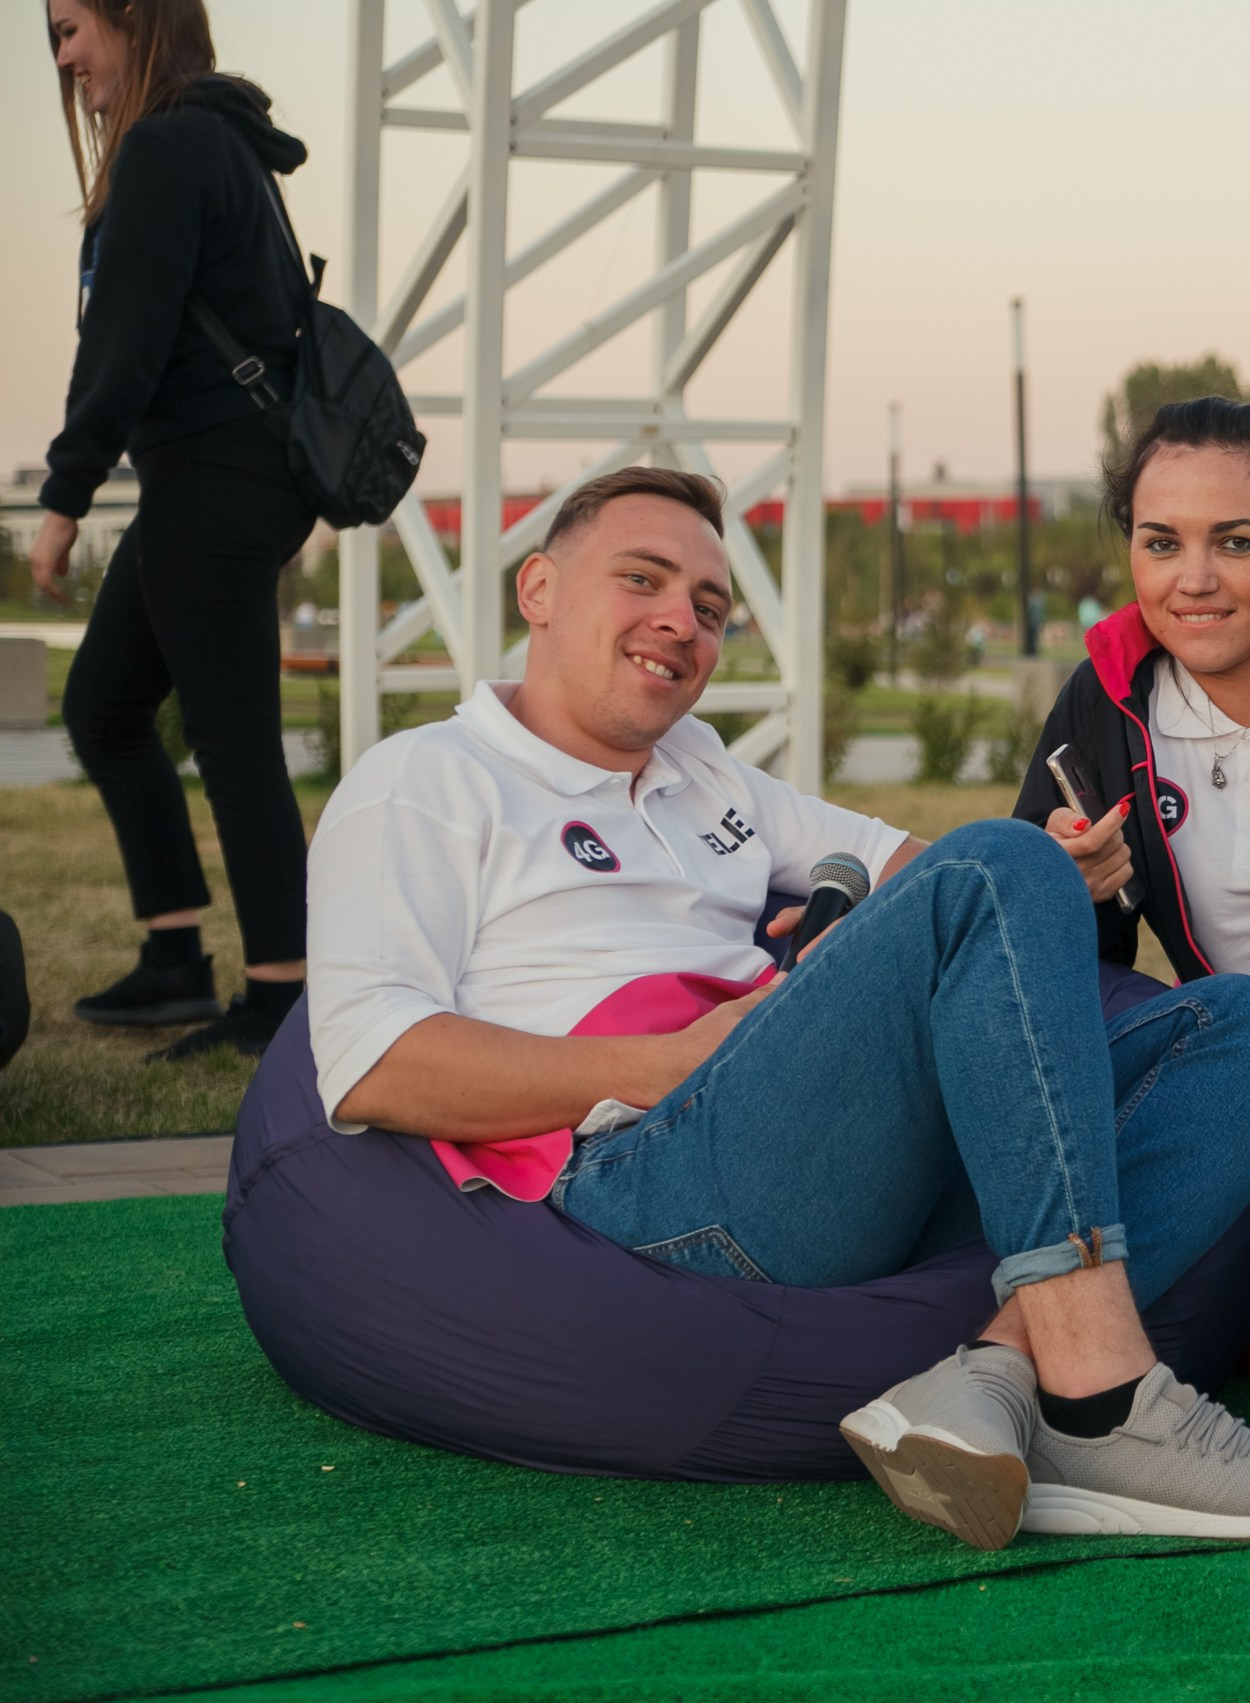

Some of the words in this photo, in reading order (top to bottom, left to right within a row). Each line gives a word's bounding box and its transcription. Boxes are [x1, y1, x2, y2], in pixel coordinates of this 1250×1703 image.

[1157, 795, 1177, 820] G
[700, 807, 755, 856] ELE
[573, 839, 611, 862] 4G
